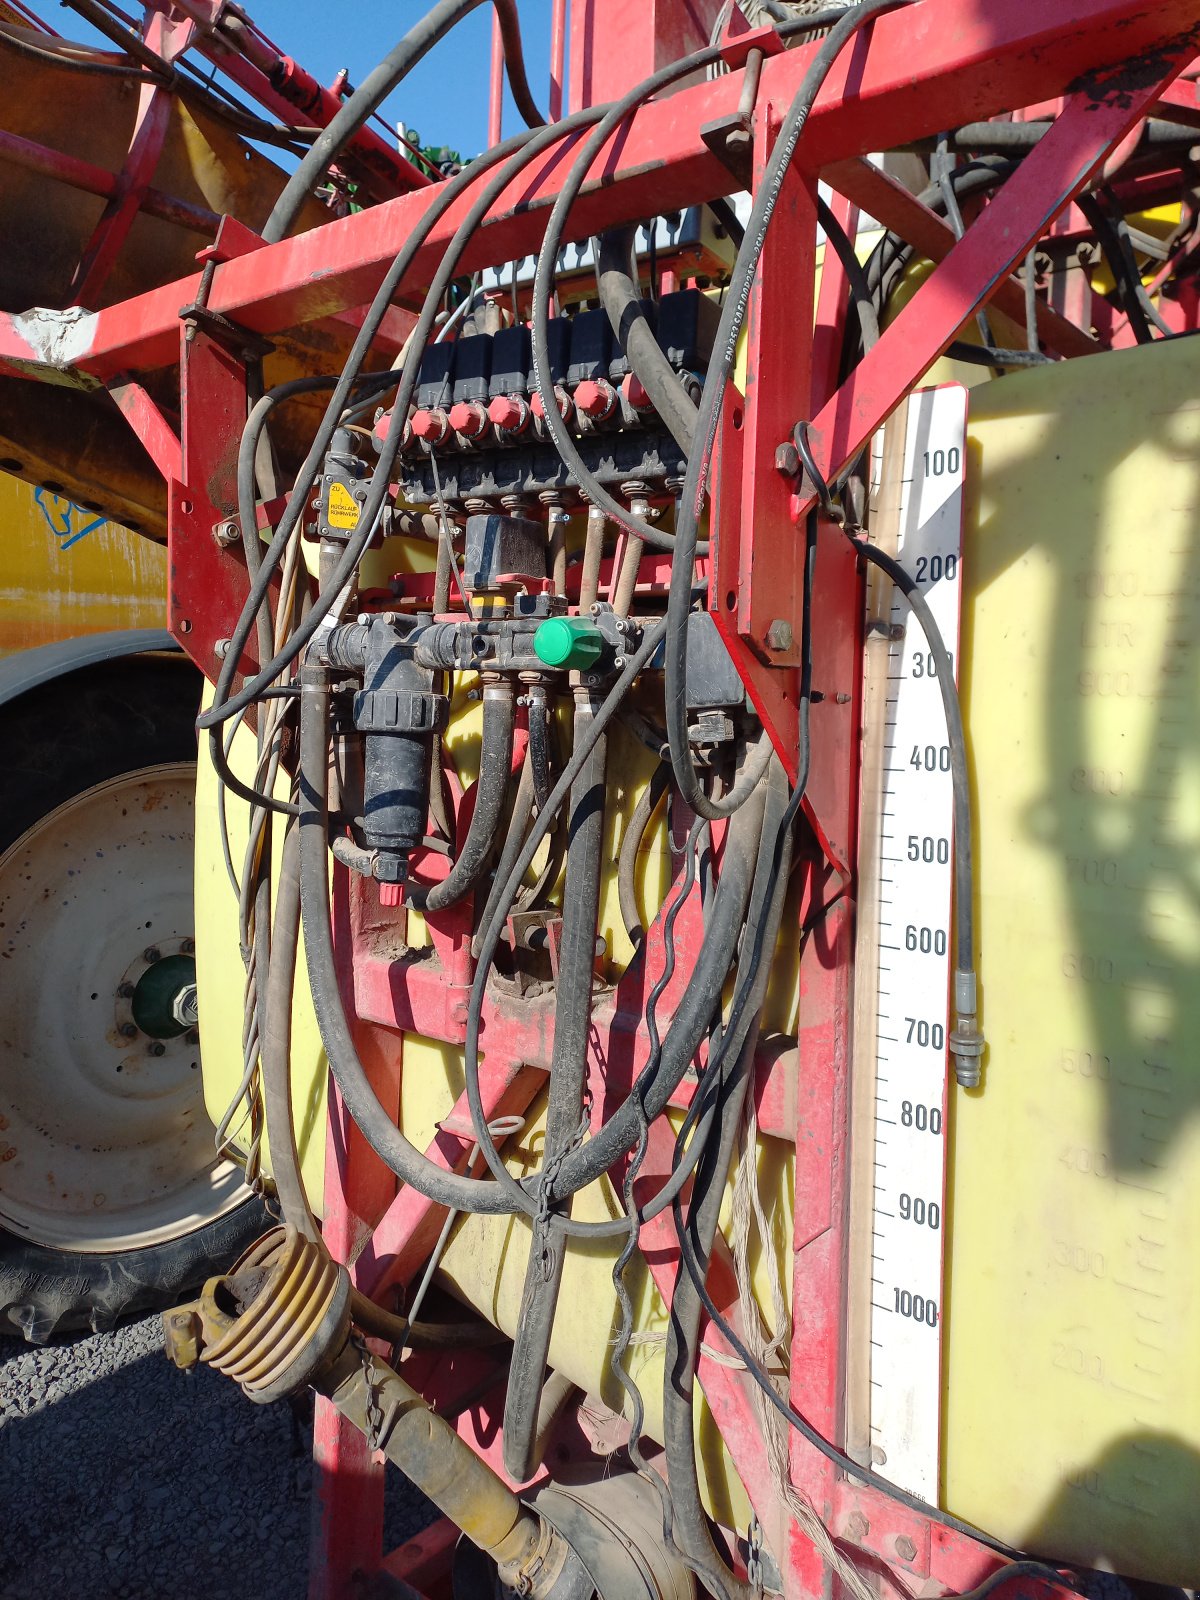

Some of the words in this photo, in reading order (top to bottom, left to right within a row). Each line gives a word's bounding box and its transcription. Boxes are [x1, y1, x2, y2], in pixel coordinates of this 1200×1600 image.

[924, 447, 960, 478] 100
[916, 554, 957, 583] 200
[910, 745, 950, 772] 400
[1071, 768, 1126, 795] 800
[907, 836, 949, 864] 500
[905, 924, 946, 956] 600
[1062, 954, 1114, 983] 600
[904, 1017, 944, 1050] 700
[1060, 1049, 1112, 1080] 500
[901, 1100, 941, 1135] 800
[1059, 1148, 1110, 1178] 400
[900, 1193, 940, 1230] 900
[1054, 1241, 1107, 1279] 300
[894, 1287, 937, 1328] 1000
[1052, 1342, 1105, 1383] 200
